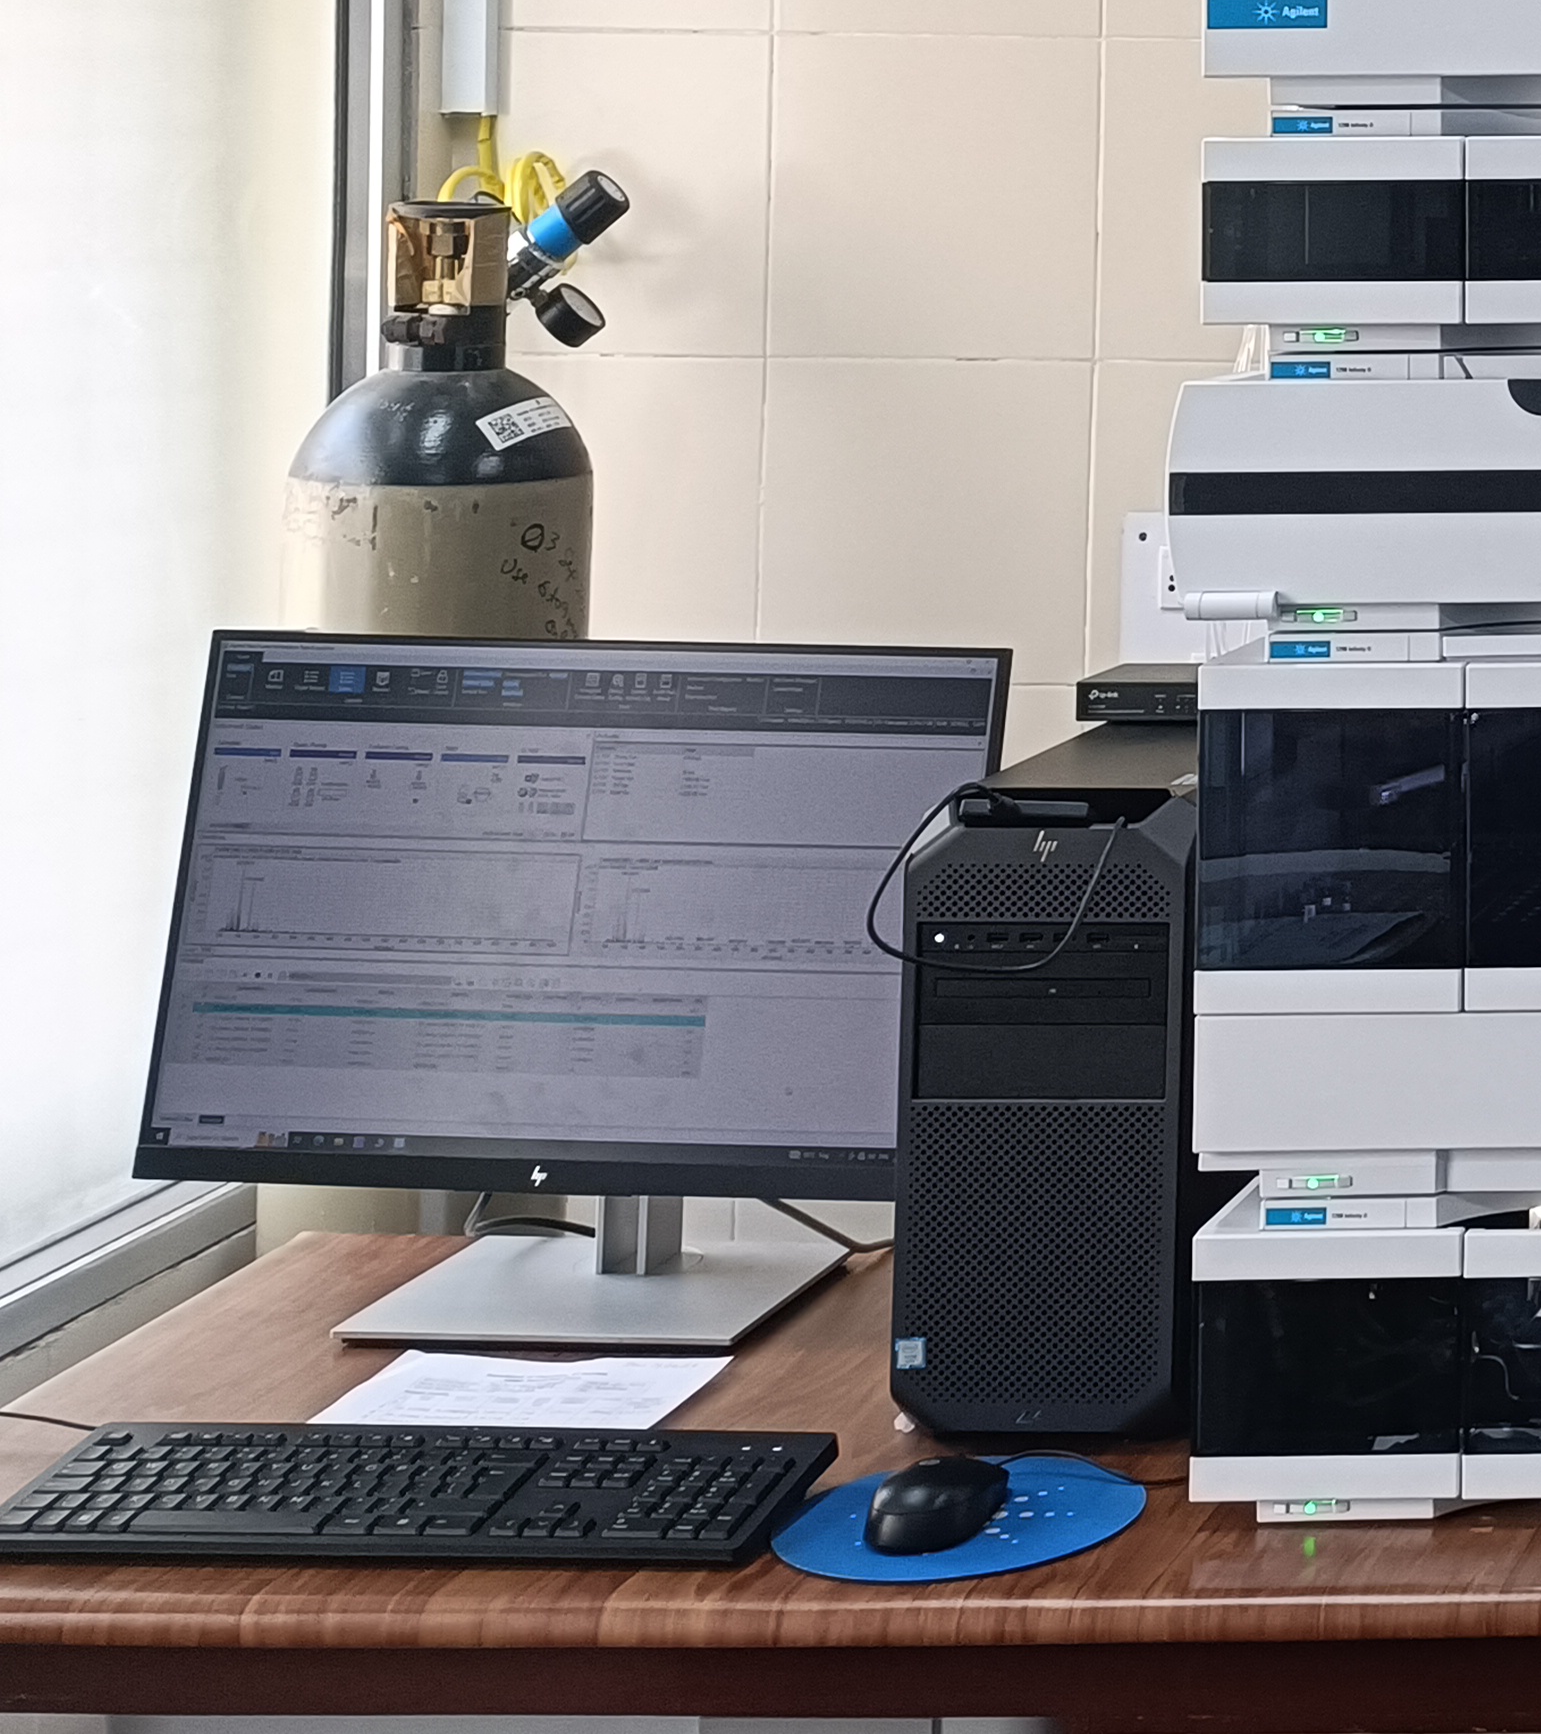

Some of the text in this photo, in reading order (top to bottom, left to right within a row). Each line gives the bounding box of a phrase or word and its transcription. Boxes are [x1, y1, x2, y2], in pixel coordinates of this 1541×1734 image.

[1282, 6, 1320, 19] Agilent
[1032, 830, 1058, 863] hp
[530, 1165, 548, 1187] hp
